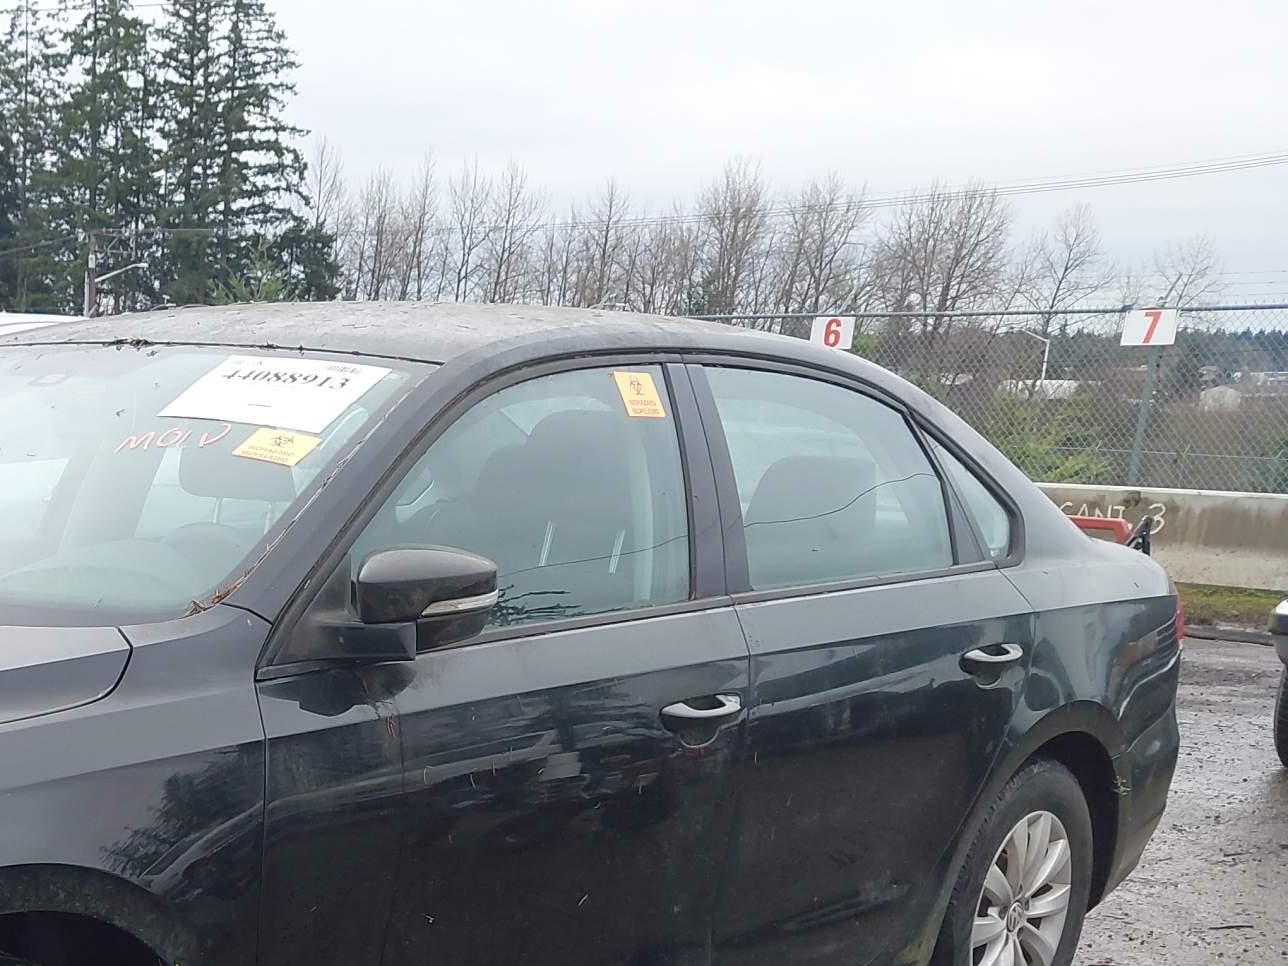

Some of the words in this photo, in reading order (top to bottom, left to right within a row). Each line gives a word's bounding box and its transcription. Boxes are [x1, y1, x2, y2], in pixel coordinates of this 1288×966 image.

[822, 318, 842, 347] 6
[1142, 311, 1161, 344] 7
[222, 369, 350, 389] 44088913
[1148, 503, 1166, 535] 3
